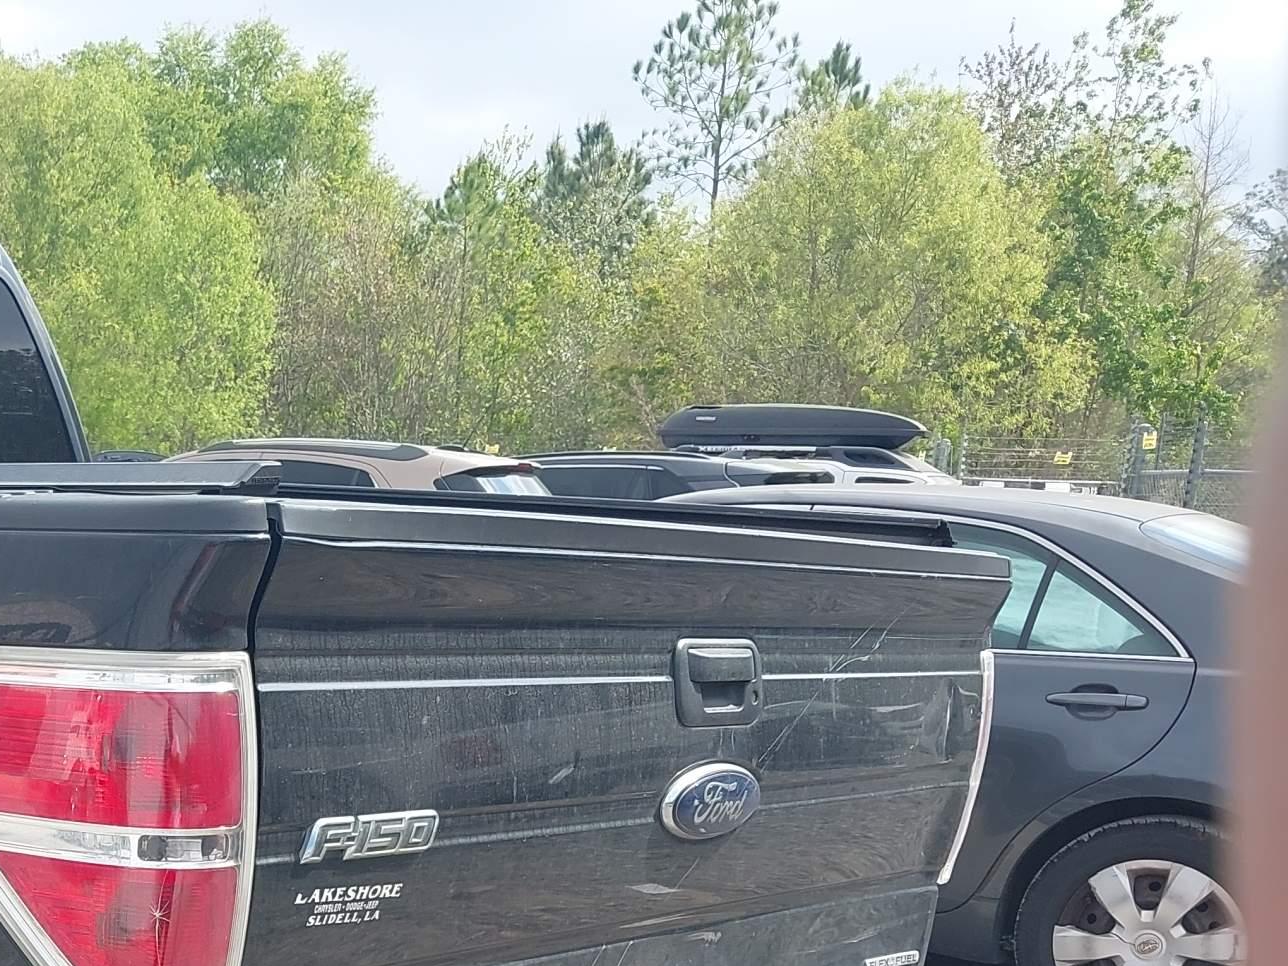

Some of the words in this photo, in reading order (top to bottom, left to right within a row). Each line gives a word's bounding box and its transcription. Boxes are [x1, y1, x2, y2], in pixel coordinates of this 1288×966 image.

[299, 808, 440, 864] F-150
[294, 883, 403, 905] LAKESHORE
[306, 912, 362, 927] SLIDELL,
[364, 910, 381, 921] LA
[895, 953, 917, 965] FUEL
